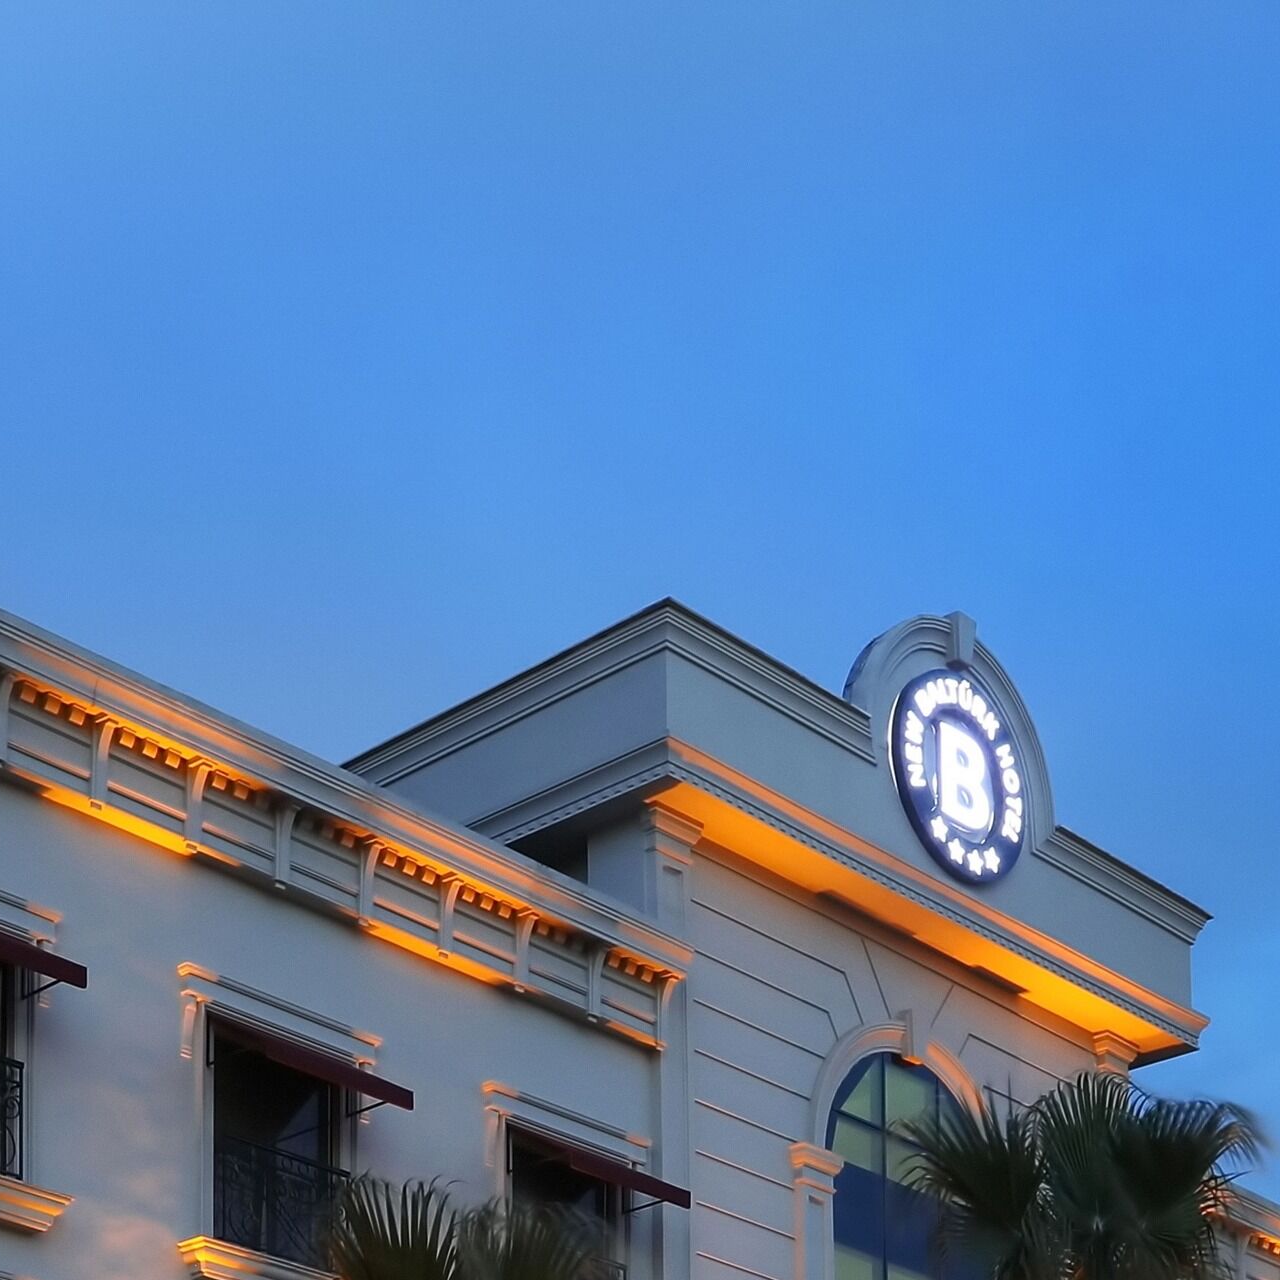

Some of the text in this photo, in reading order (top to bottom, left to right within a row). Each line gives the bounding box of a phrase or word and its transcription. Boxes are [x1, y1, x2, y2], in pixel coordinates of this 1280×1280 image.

[903, 677, 1023, 844] NEW BALTÜRK HOTEL
[940, 720, 991, 830] B
